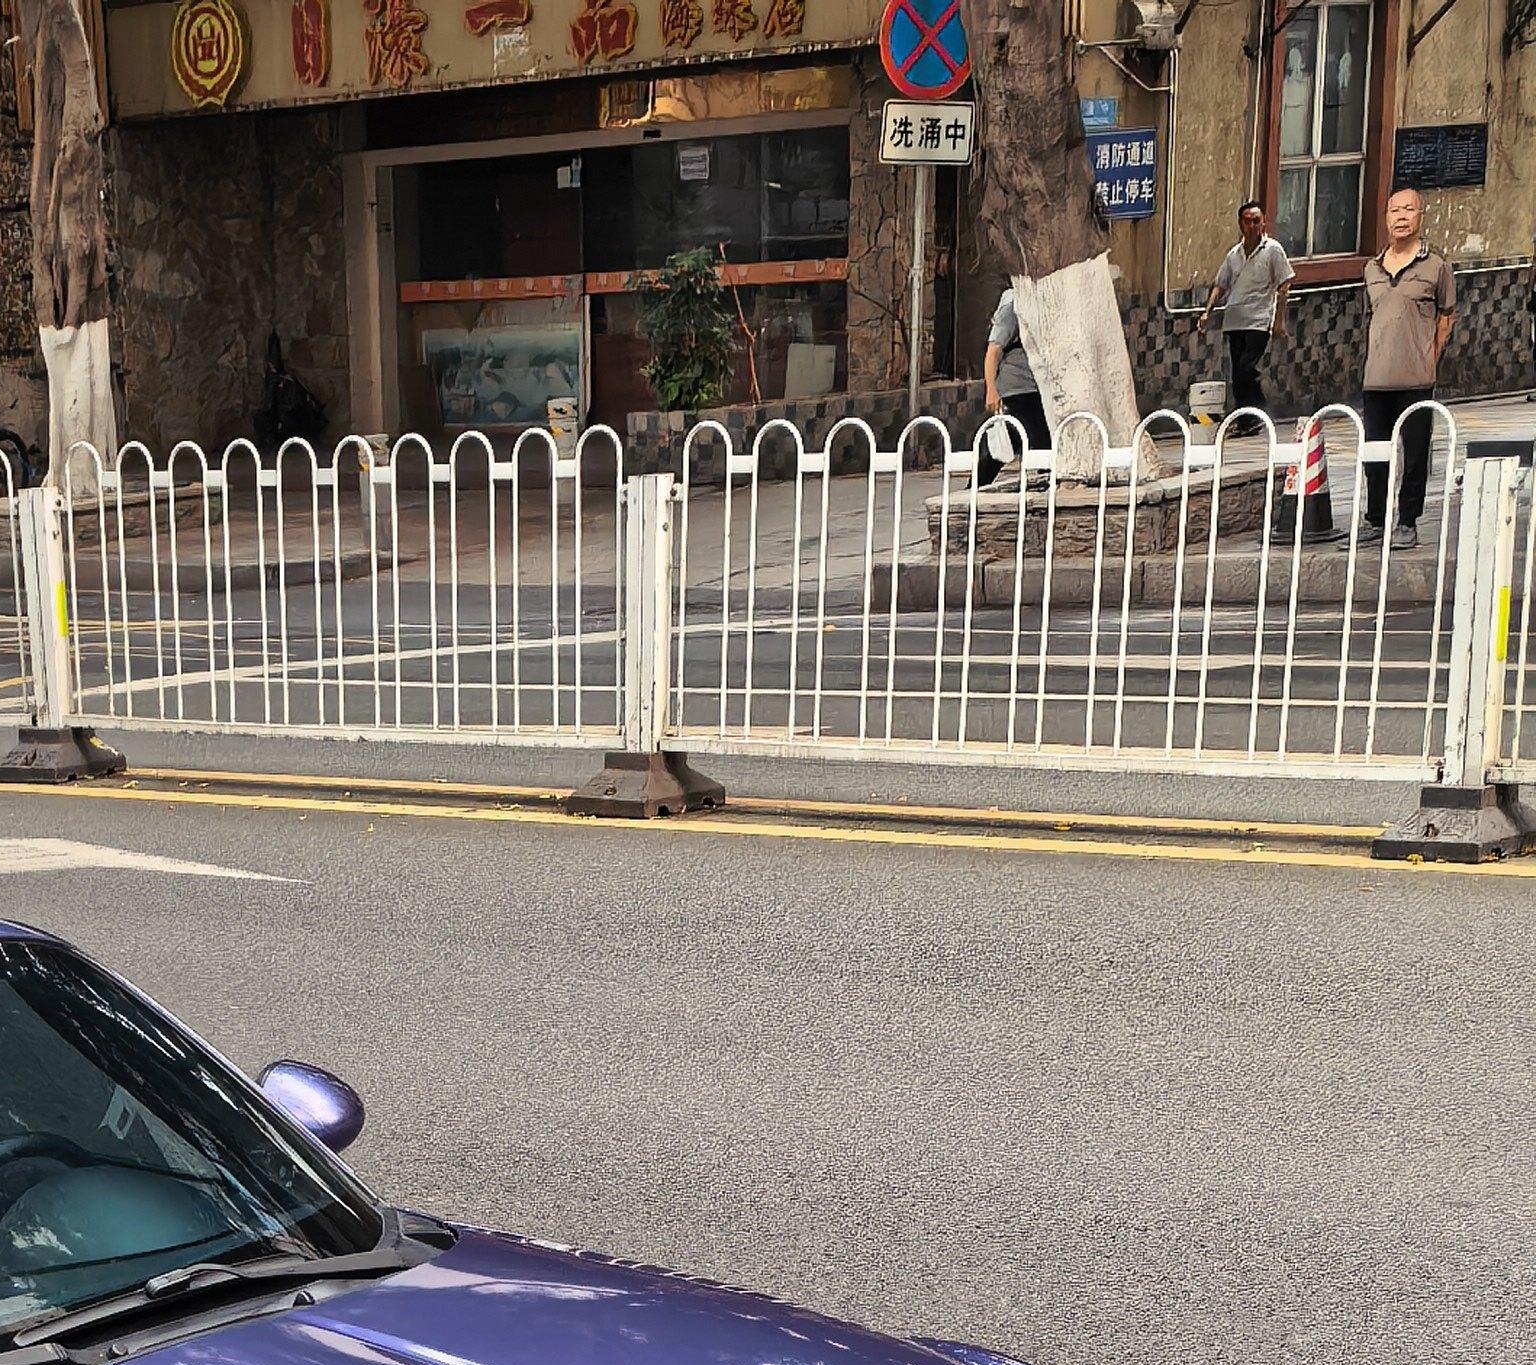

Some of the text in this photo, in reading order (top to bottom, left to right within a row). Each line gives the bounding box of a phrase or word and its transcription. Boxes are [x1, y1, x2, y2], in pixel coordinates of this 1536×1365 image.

[1095, 140, 1155, 169] 消防通道
[1095, 177, 1154, 206] 禁止停车
